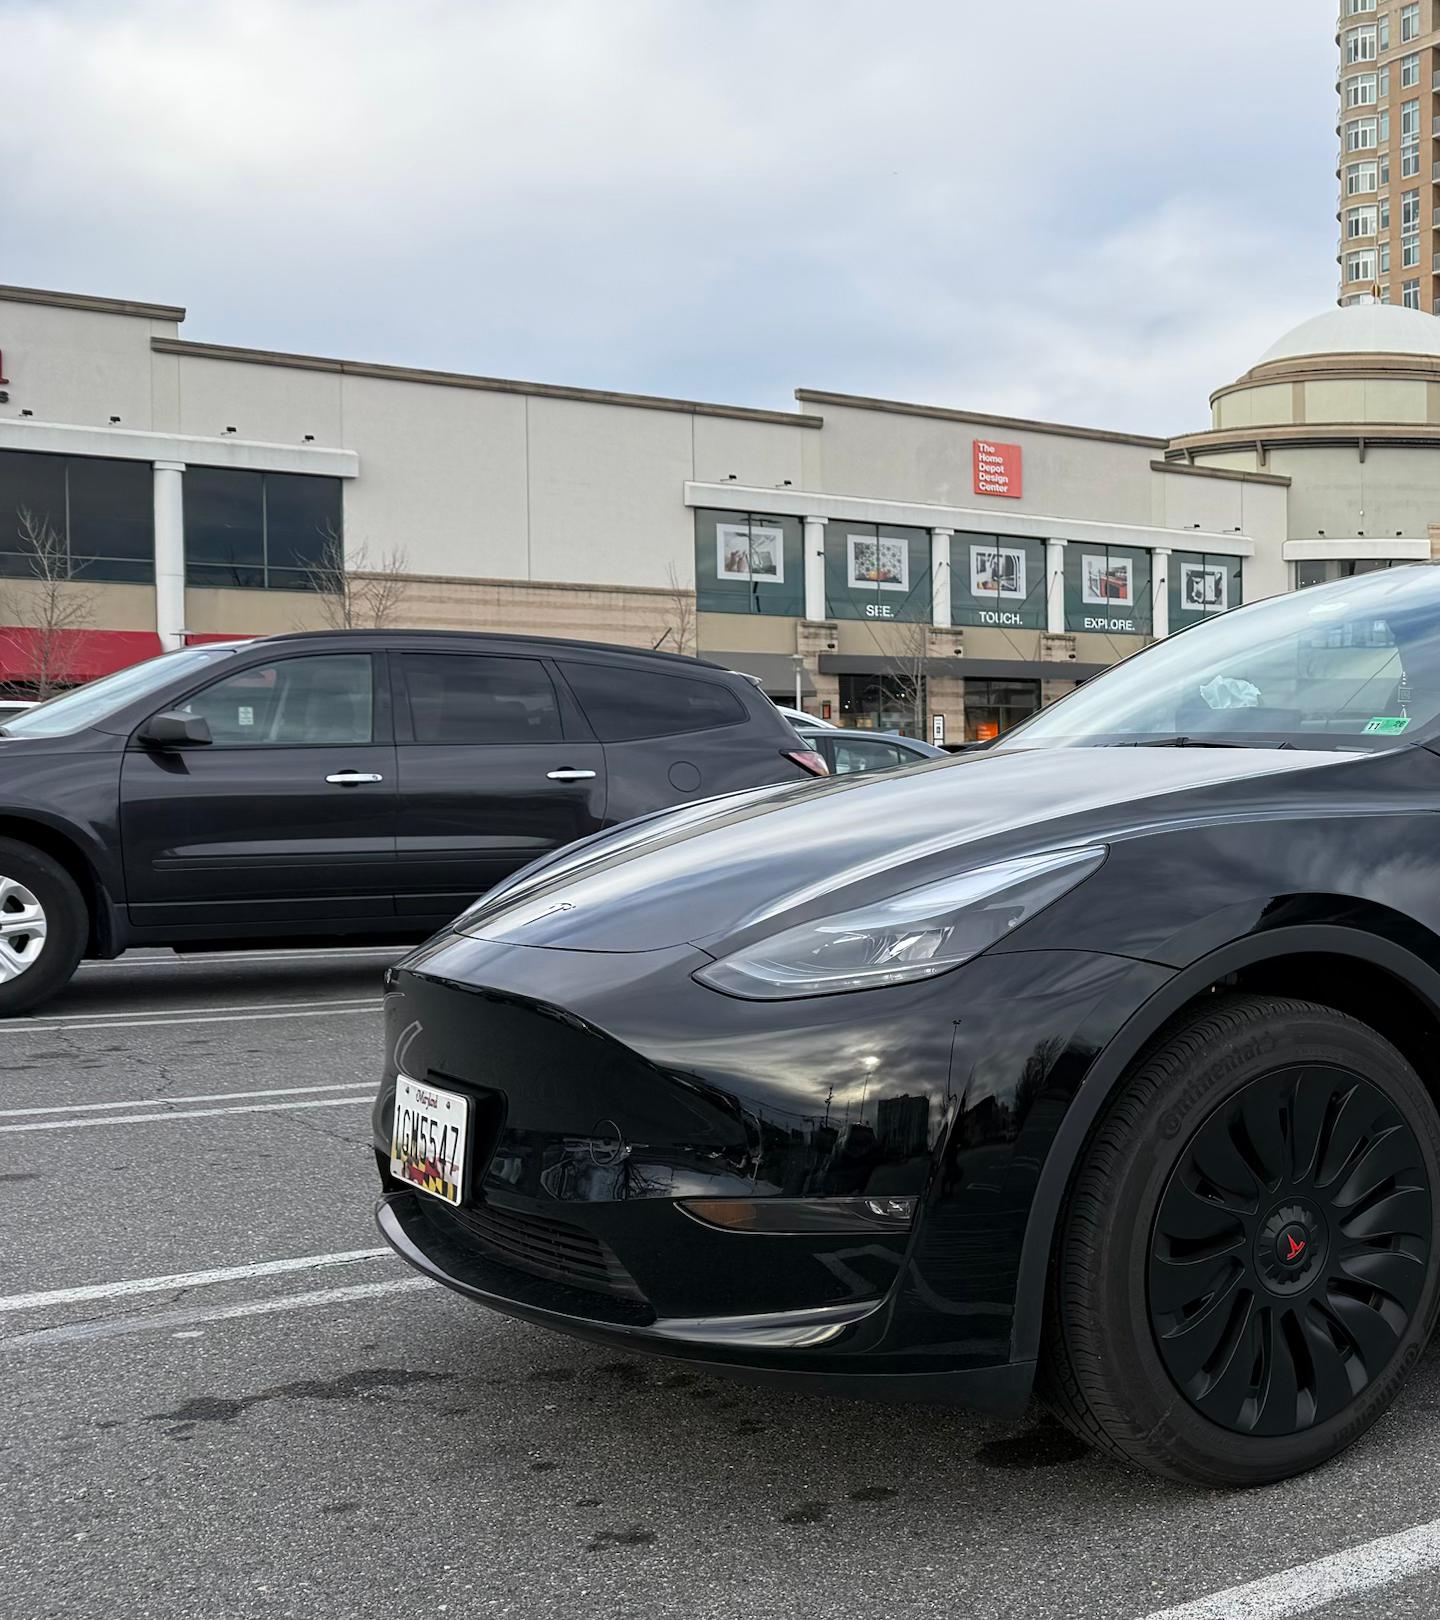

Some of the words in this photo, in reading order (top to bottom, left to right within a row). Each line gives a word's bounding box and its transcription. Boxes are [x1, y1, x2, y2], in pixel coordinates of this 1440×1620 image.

[978, 443, 996, 453] The
[978, 452, 1004, 464] Home
[978, 462, 1005, 474] Depot
[978, 472, 1009, 485] Design
[979, 482, 1009, 493] Center
[865, 605, 894, 618] SEE.
[978, 611, 1023, 625] TOUCH.
[1084, 617, 1136, 631] EXPLORE.
